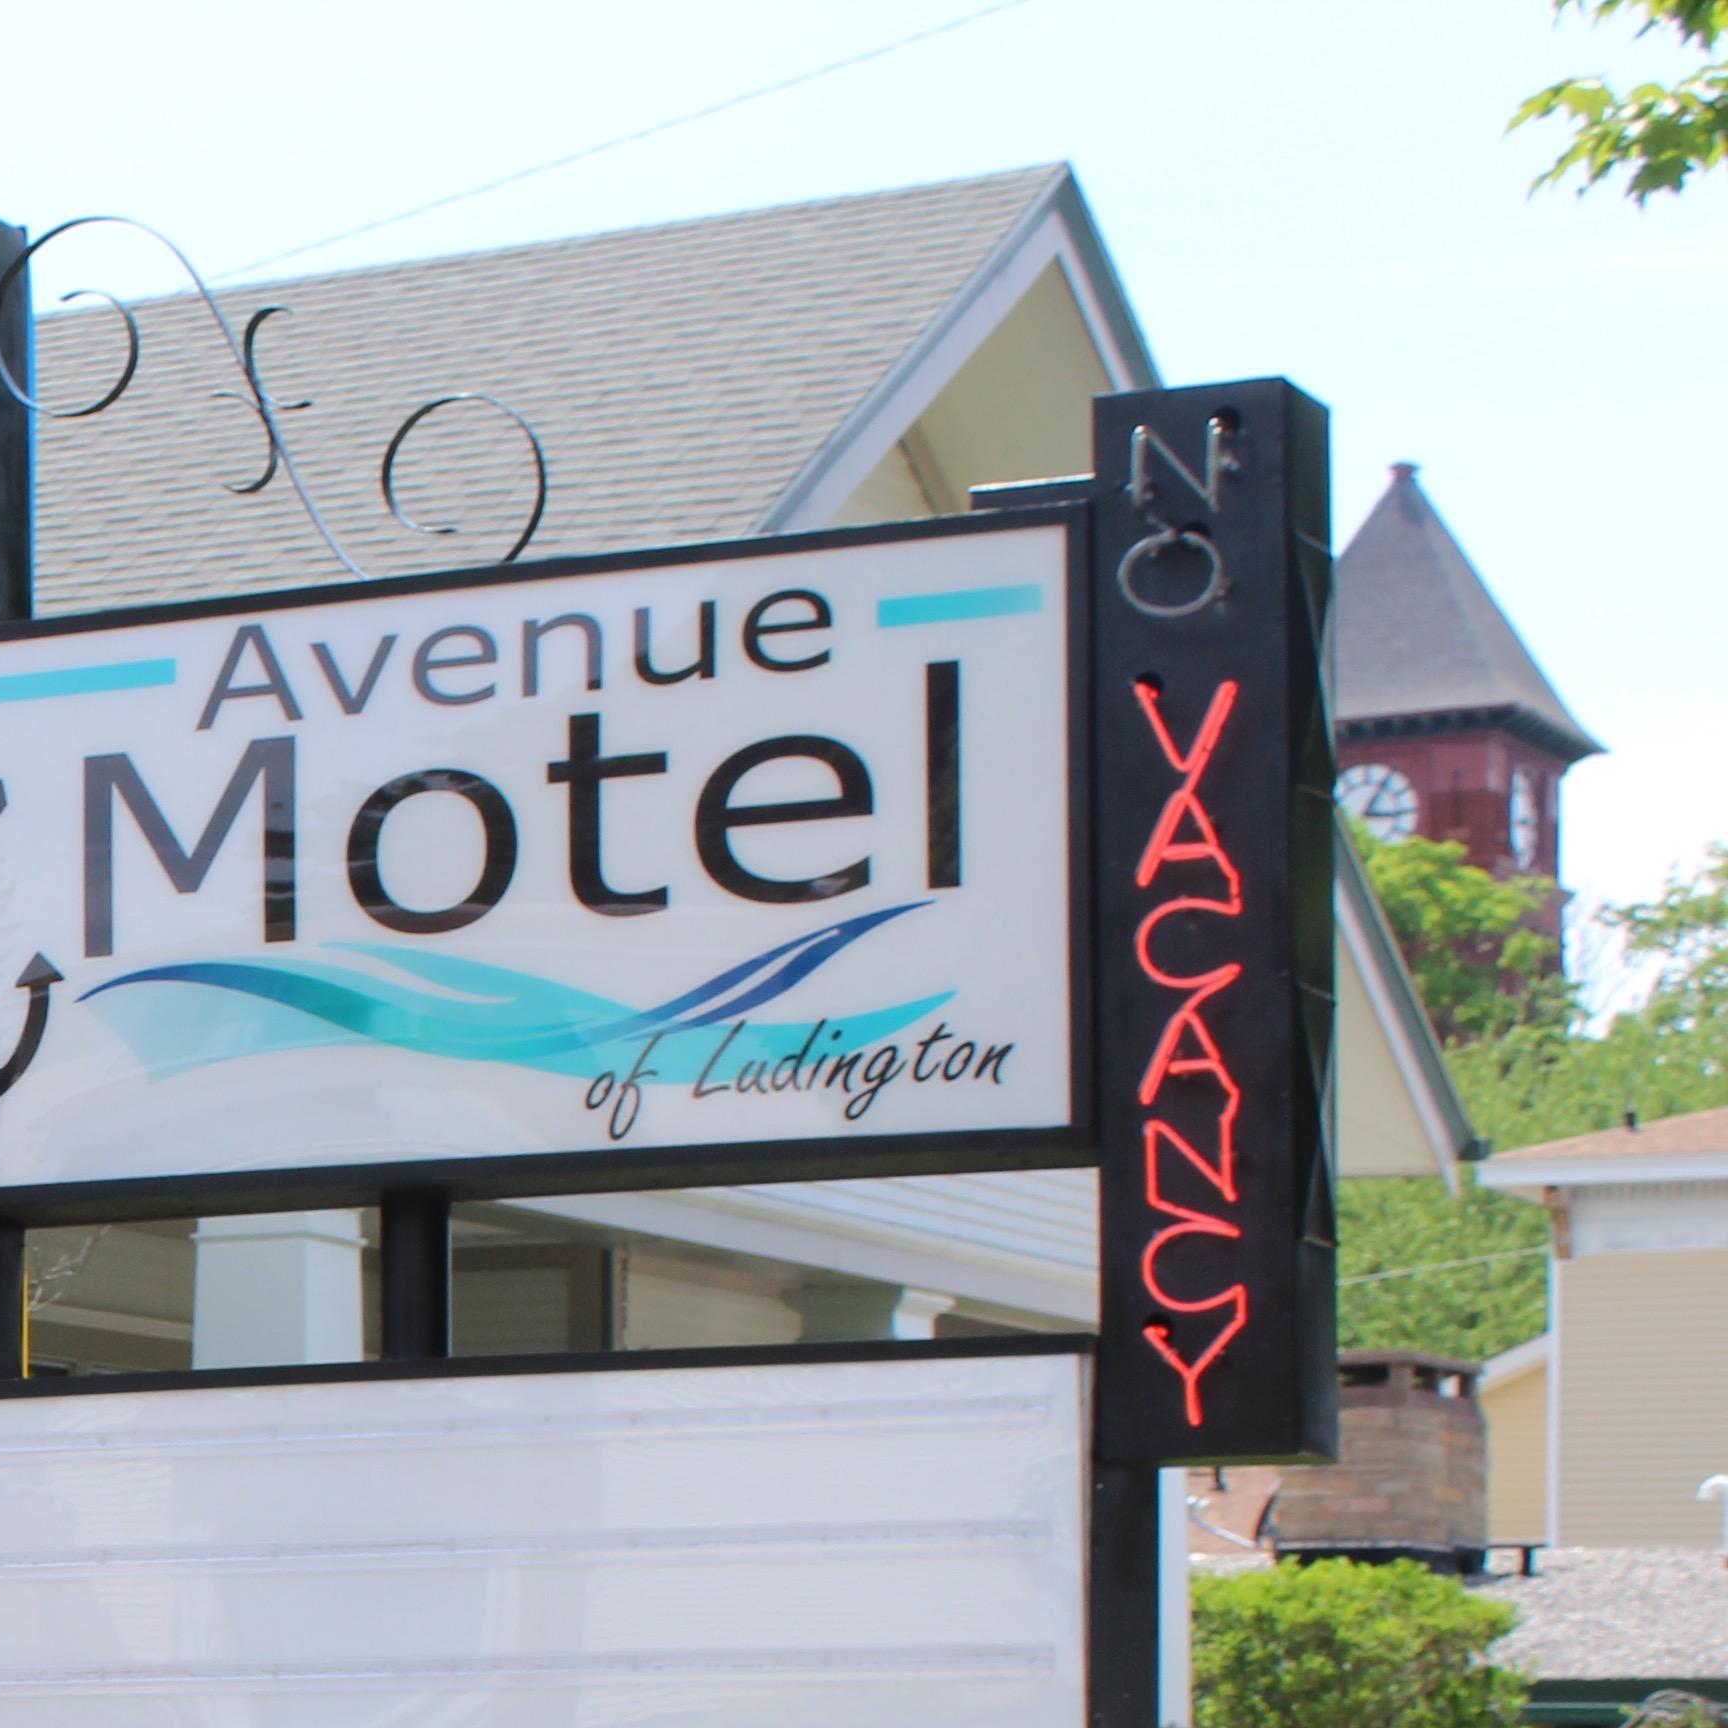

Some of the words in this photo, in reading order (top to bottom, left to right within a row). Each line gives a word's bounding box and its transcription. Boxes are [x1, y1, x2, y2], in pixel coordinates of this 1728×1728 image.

[1117, 417, 1224, 618] NO
[196, 587, 832, 730] Avenue
[83, 660, 961, 958] Motel
[585, 1033, 663, 1142] of
[693, 1018, 1014, 1122] Ludington
[1135, 679, 1249, 1427] VACANCY
